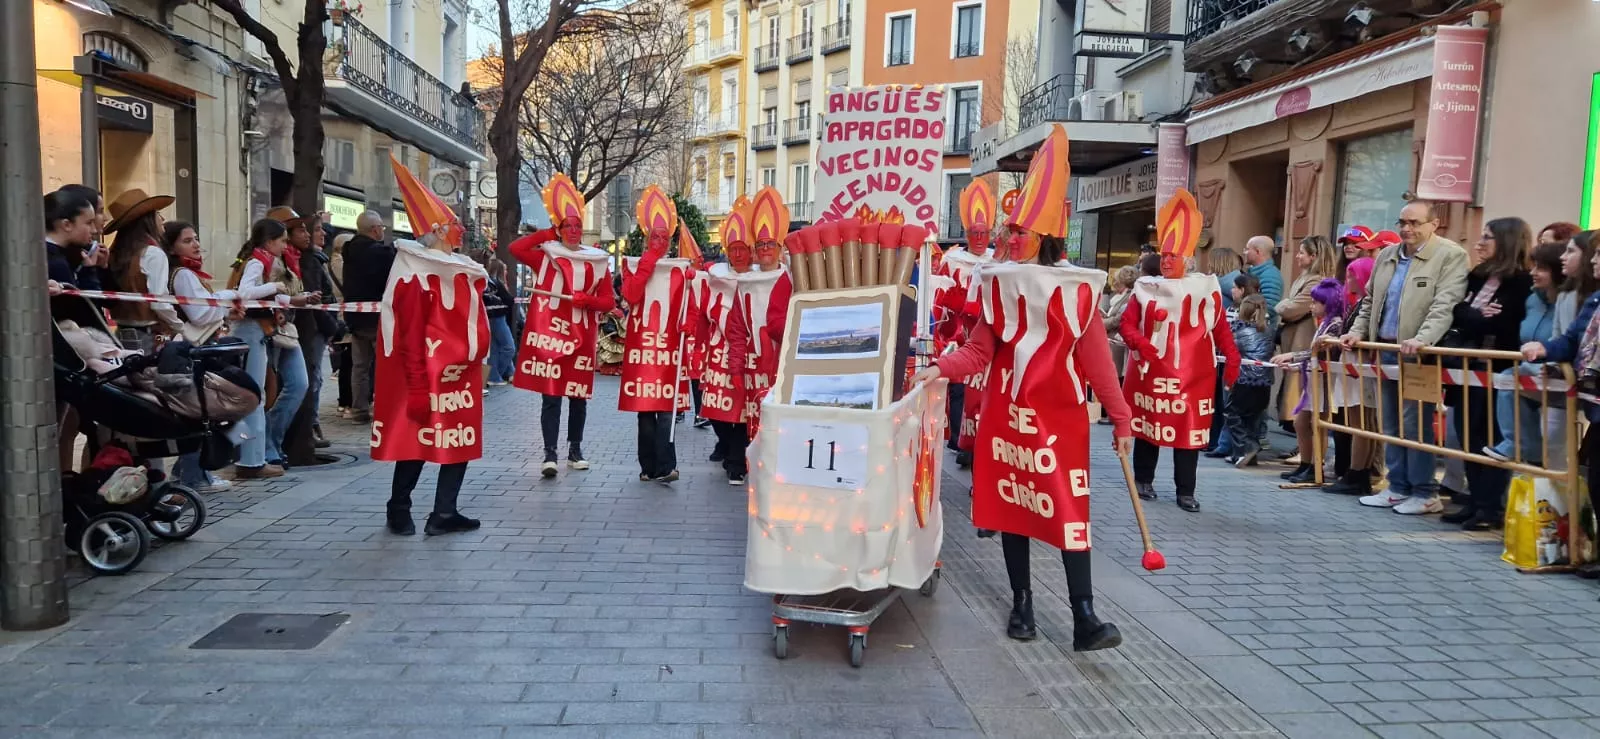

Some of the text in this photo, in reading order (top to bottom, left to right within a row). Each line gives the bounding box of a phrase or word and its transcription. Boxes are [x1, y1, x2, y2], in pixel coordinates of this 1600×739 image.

[1442, 61, 1475, 71] Turrón
[1432, 102, 1476, 115] de Jijona
[827, 117, 944, 143] APAGADO
[820, 146, 939, 176] VECINOS
[1080, 168, 1132, 203] AQUILLUÉ
[537, 296, 549, 312] Y
[549, 316, 571, 336] SE
[425, 337, 442, 357] Y
[526, 332, 593, 371] ARMÓ EL
[642, 331, 668, 348] SE
[1001, 367, 1013, 394] Y
[1137, 360, 1149, 381] Y
[1153, 377, 1180, 394] SE
[1134, 392, 1214, 416] ARMÓ EL
[1008, 402, 1038, 435] SE
[803, 438, 838, 472] 11
[991, 434, 1057, 474] ARMÓ
